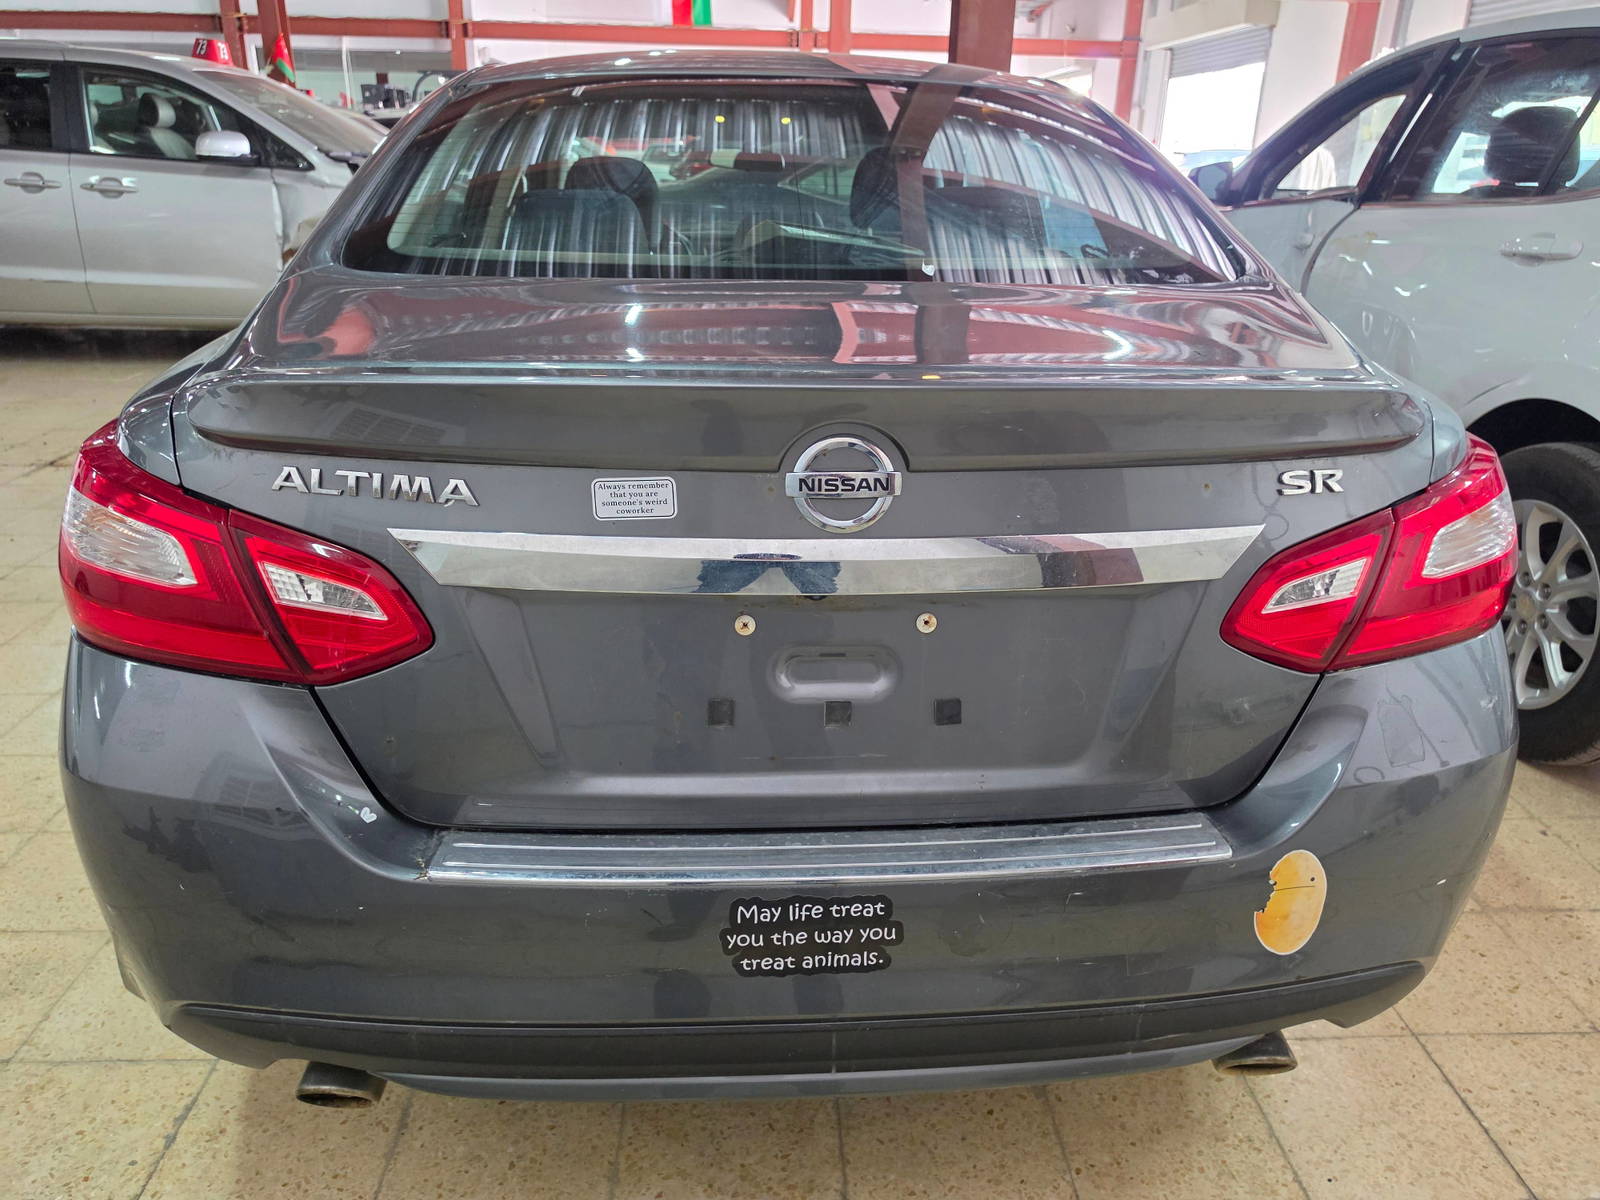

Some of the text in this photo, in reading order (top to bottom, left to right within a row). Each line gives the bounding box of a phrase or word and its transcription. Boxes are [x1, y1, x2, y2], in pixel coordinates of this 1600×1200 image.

[271, 466, 480, 507] ALTIMA
[598, 483, 626, 491] Always
[798, 477, 890, 492] NISSAN
[1276, 469, 1345, 496] SR
[601, 499, 643, 507] someone's
[737, 902, 886, 925] May life treat
[727, 927, 897, 949] you the way you
[740, 951, 884, 971] treat animals.
